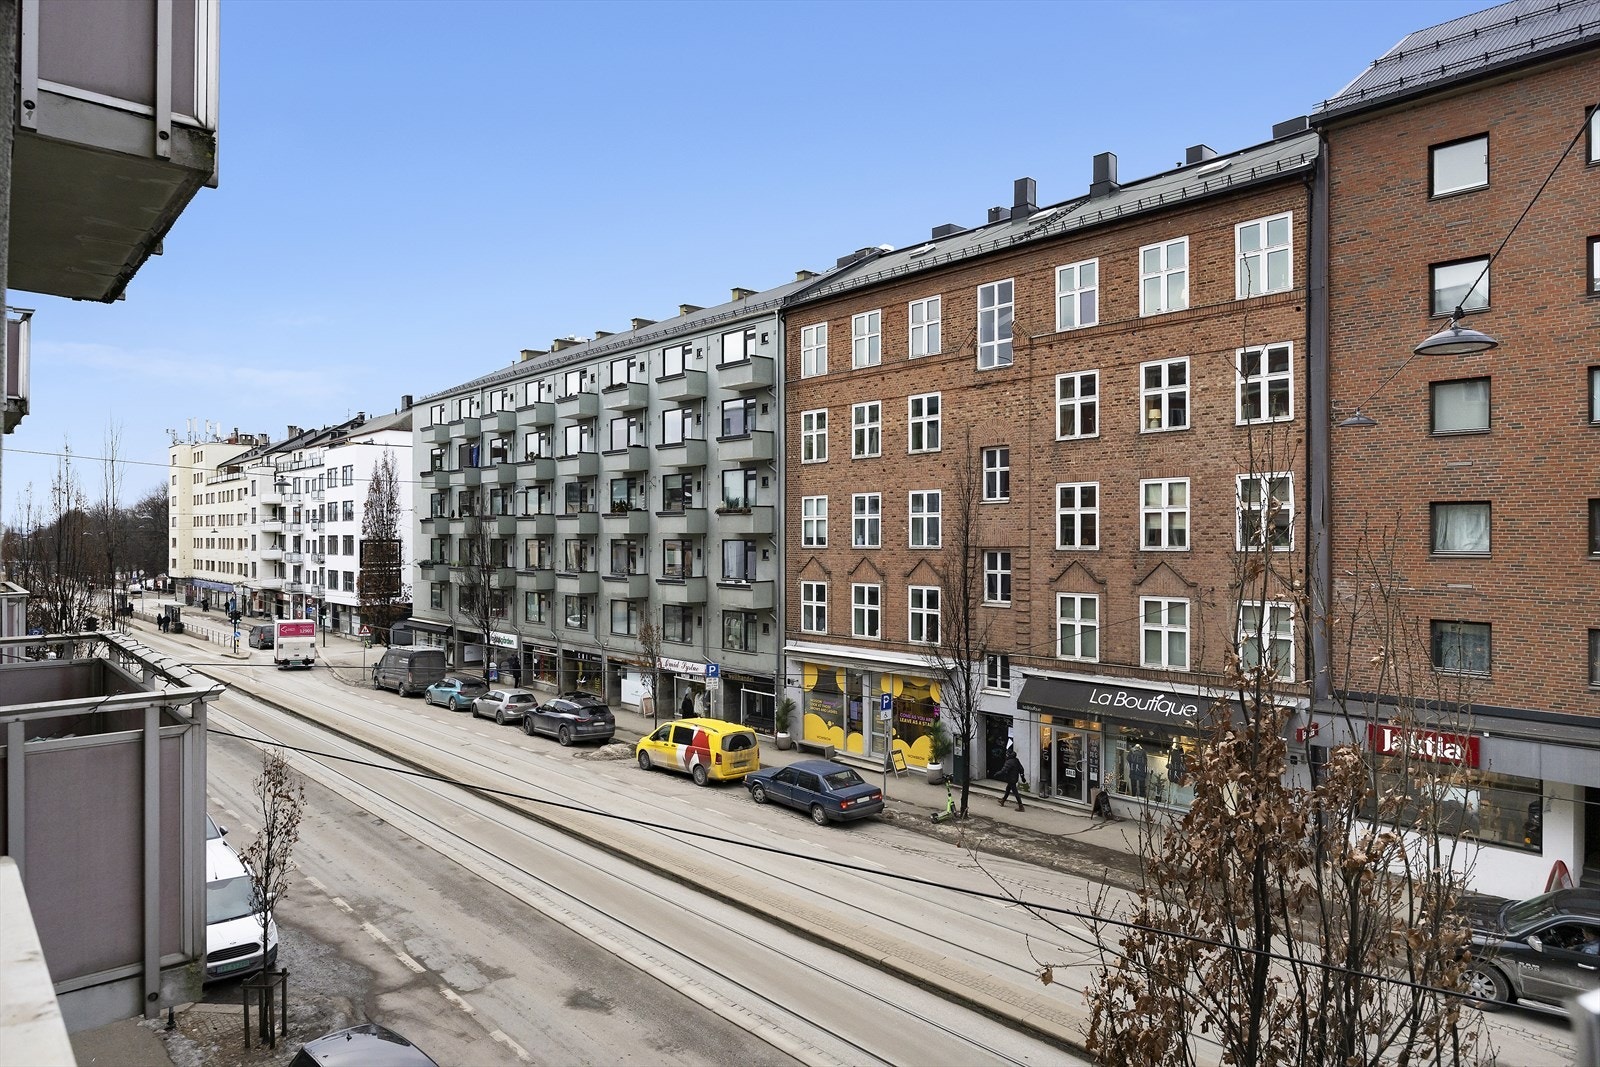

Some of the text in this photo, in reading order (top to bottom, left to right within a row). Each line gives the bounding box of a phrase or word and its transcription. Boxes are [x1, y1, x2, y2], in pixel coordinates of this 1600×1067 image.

[709, 665, 716, 676] P
[883, 695, 890, 709] P
[1089, 689, 1198, 717] La Boutique
